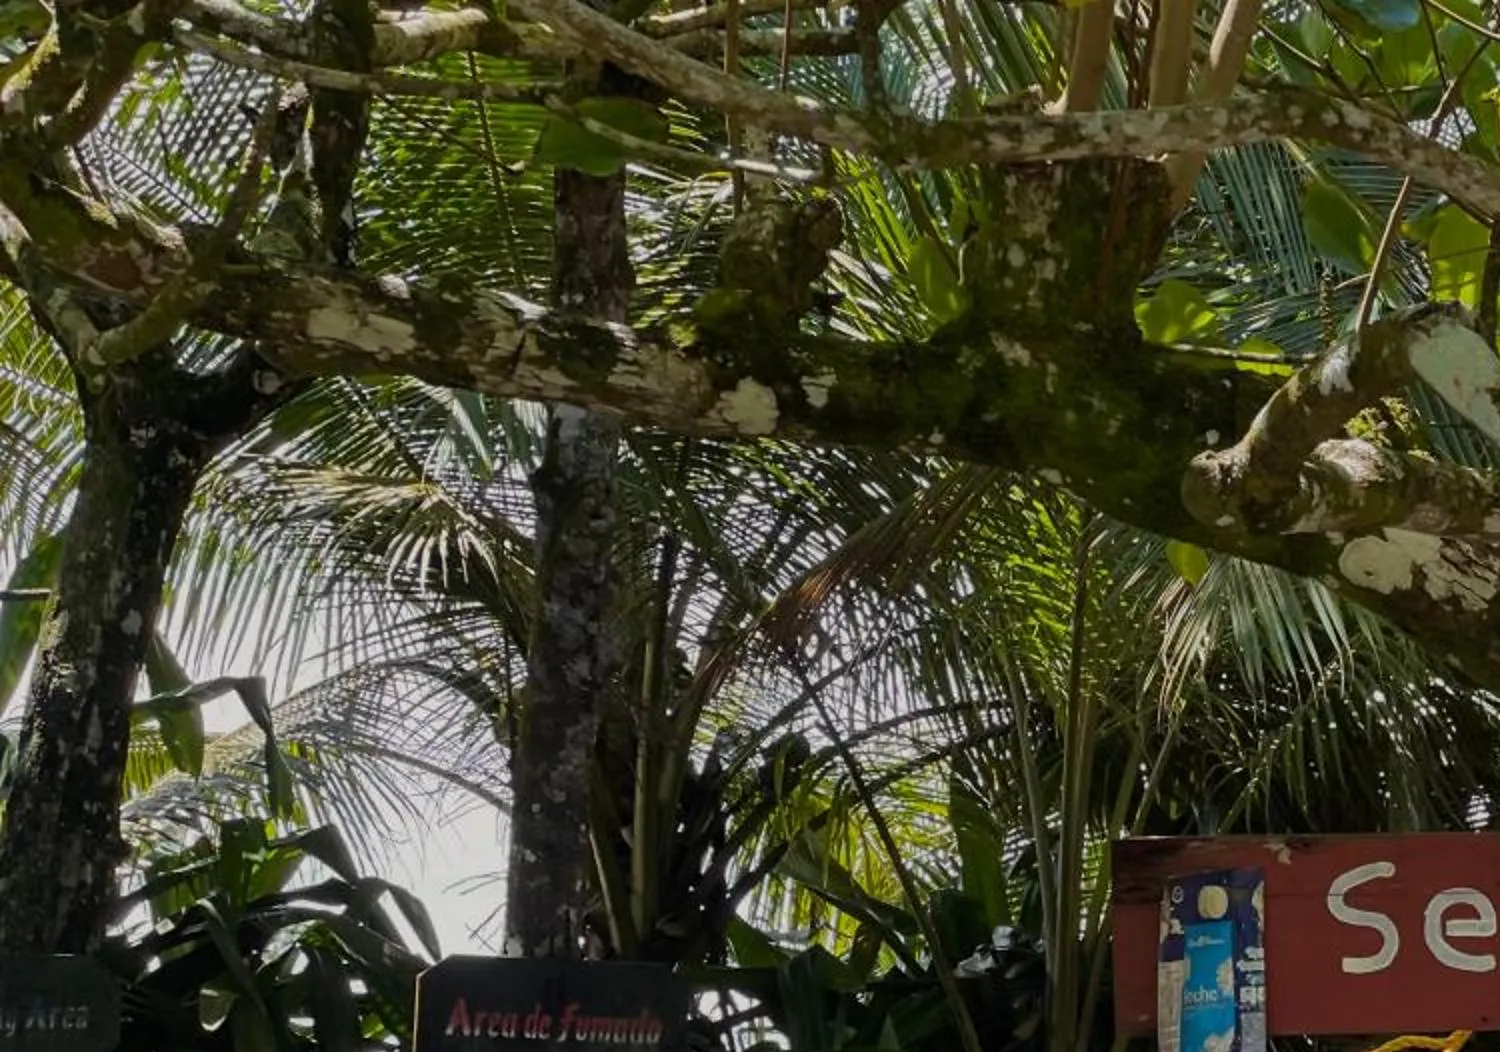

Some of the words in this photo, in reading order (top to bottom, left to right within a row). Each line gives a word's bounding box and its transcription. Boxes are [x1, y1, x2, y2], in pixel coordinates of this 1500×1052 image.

[1328, 861, 1497, 974] Se
[445, 997, 517, 1039] Area
[523, 1001, 550, 1041] de
